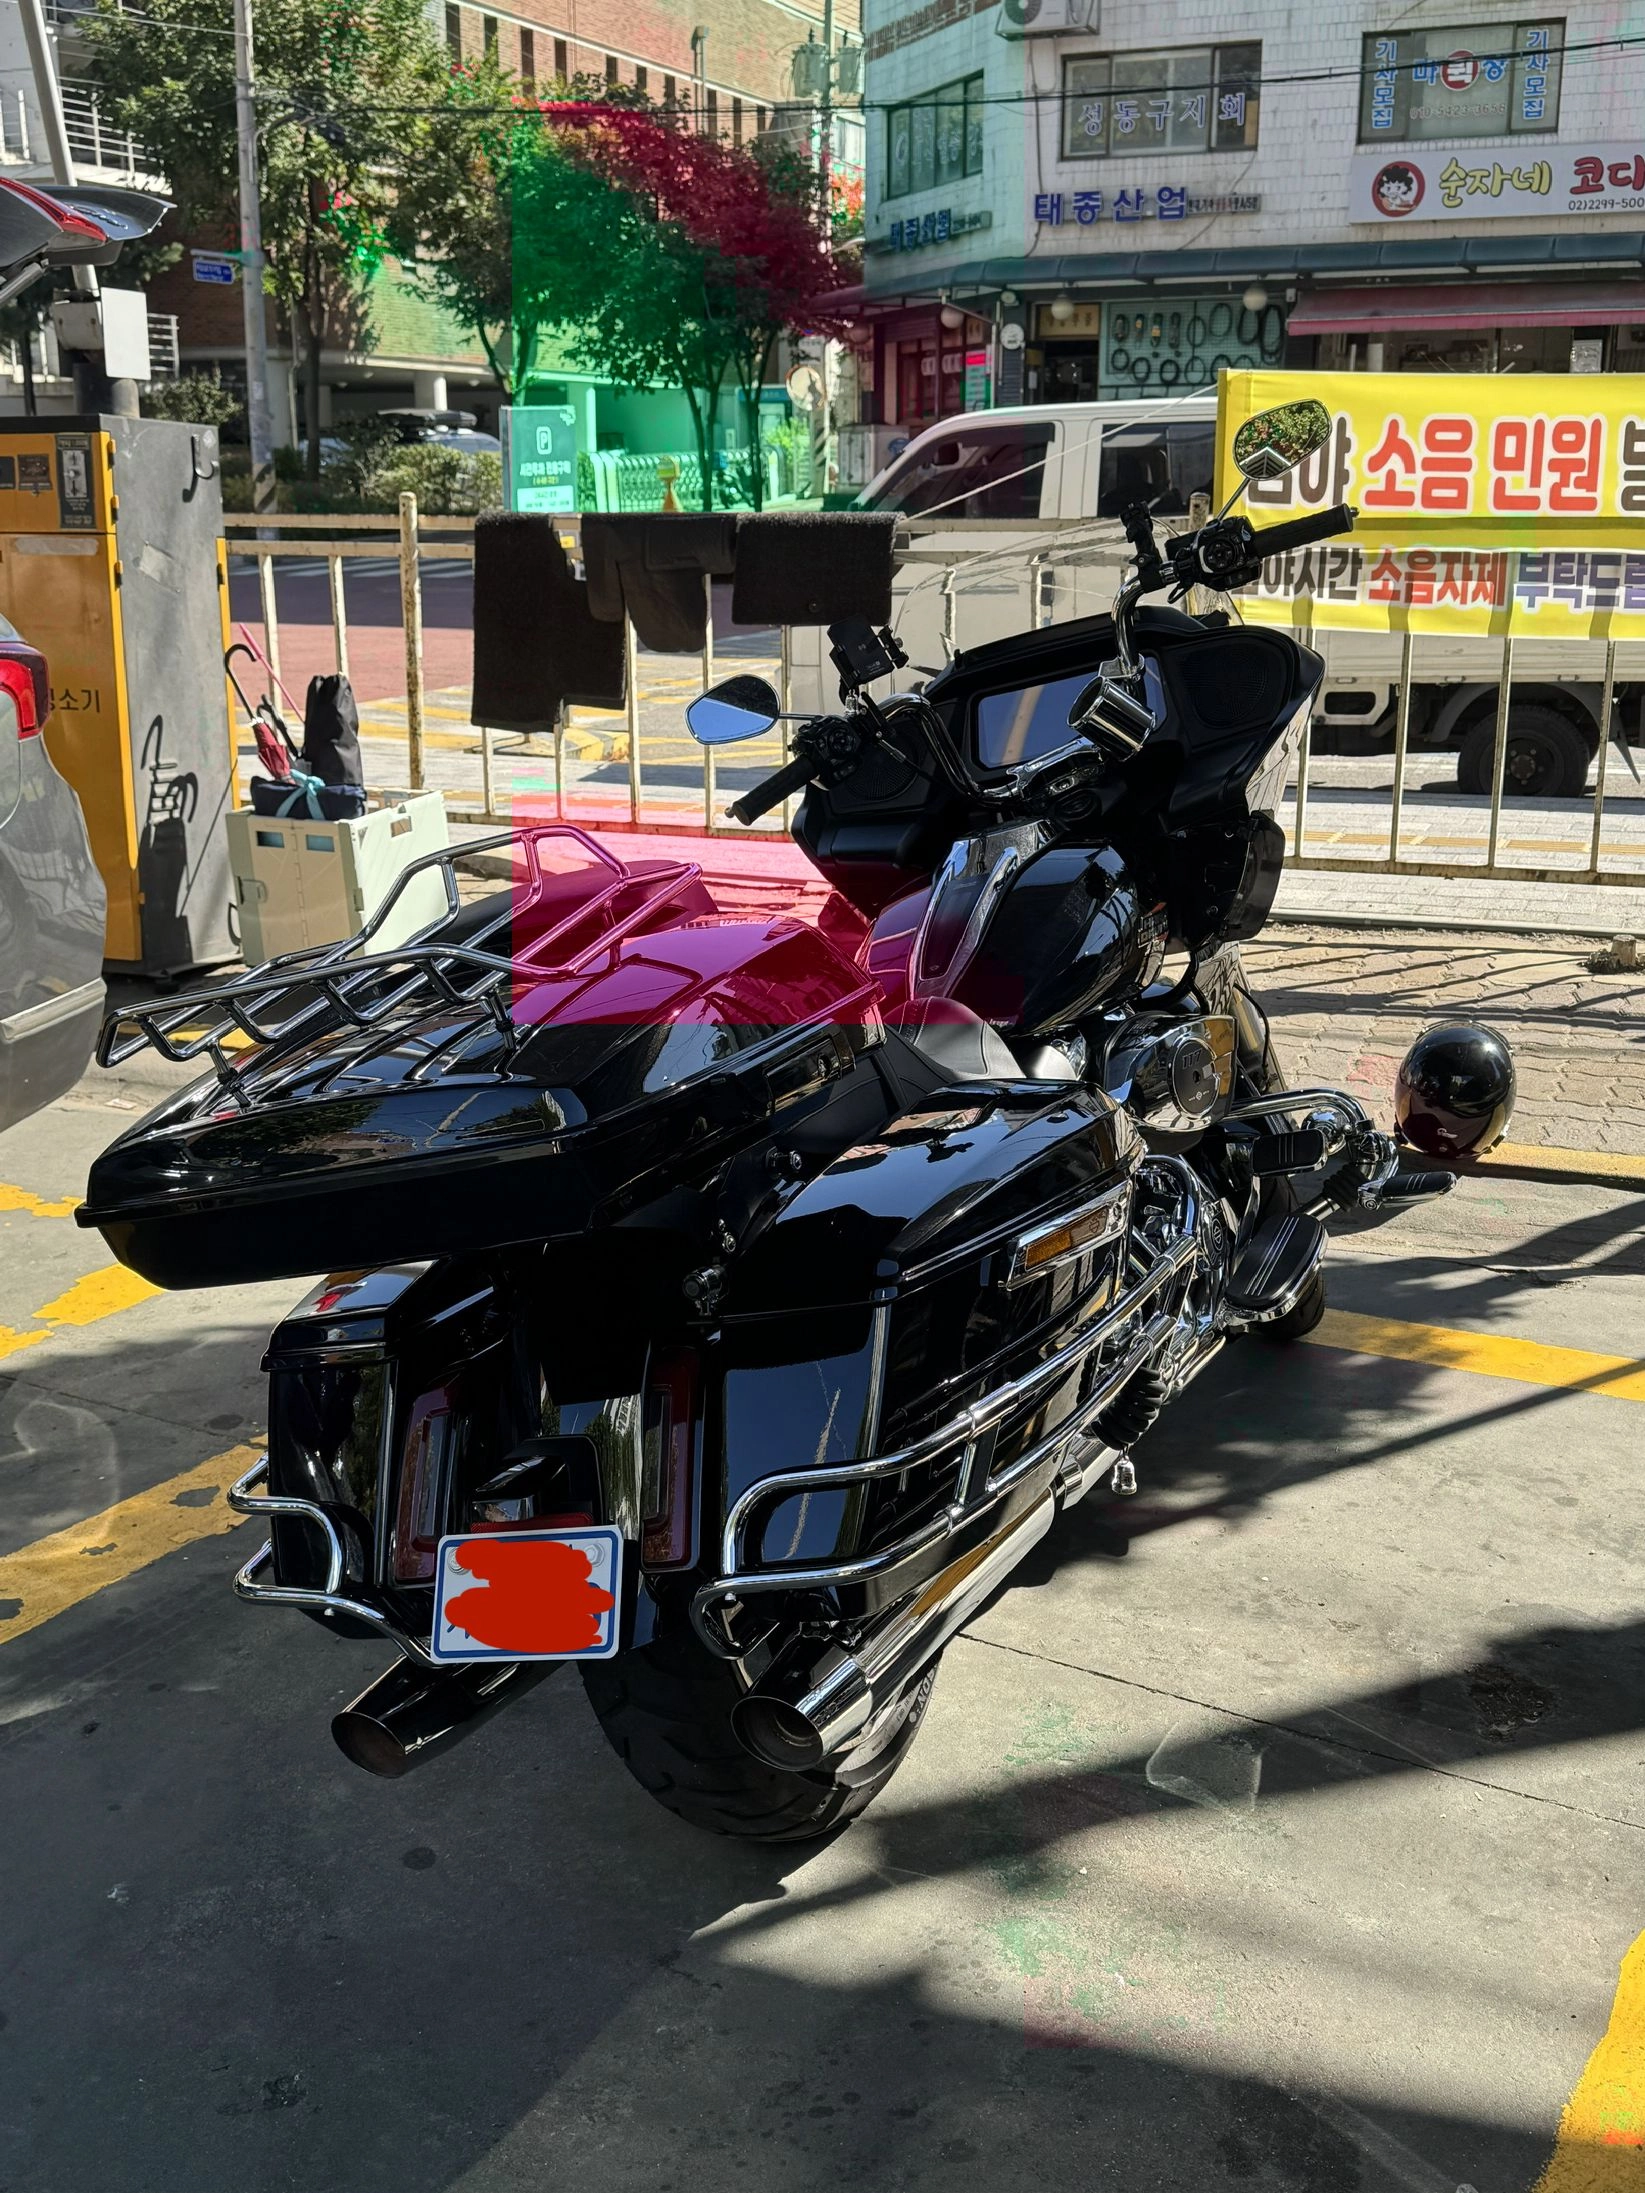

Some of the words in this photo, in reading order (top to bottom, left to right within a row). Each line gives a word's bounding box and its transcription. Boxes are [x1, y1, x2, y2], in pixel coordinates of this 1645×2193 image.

[1372, 40, 1399, 129] 기사모집
[1523, 30, 1550, 120] 기사모집
[1078, 92, 1246, 136] 성동구지회
[1034, 186, 1188, 226] 태종산업
[1439, 157, 1552, 208] 순자네
[1247, 416, 1351, 504] 야
[1364, 418, 1474, 511] 소음
[1493, 418, 1603, 512] 민원
[1231, 546, 1363, 600] 야시간
[1368, 549, 1508, 606] 소음자제
